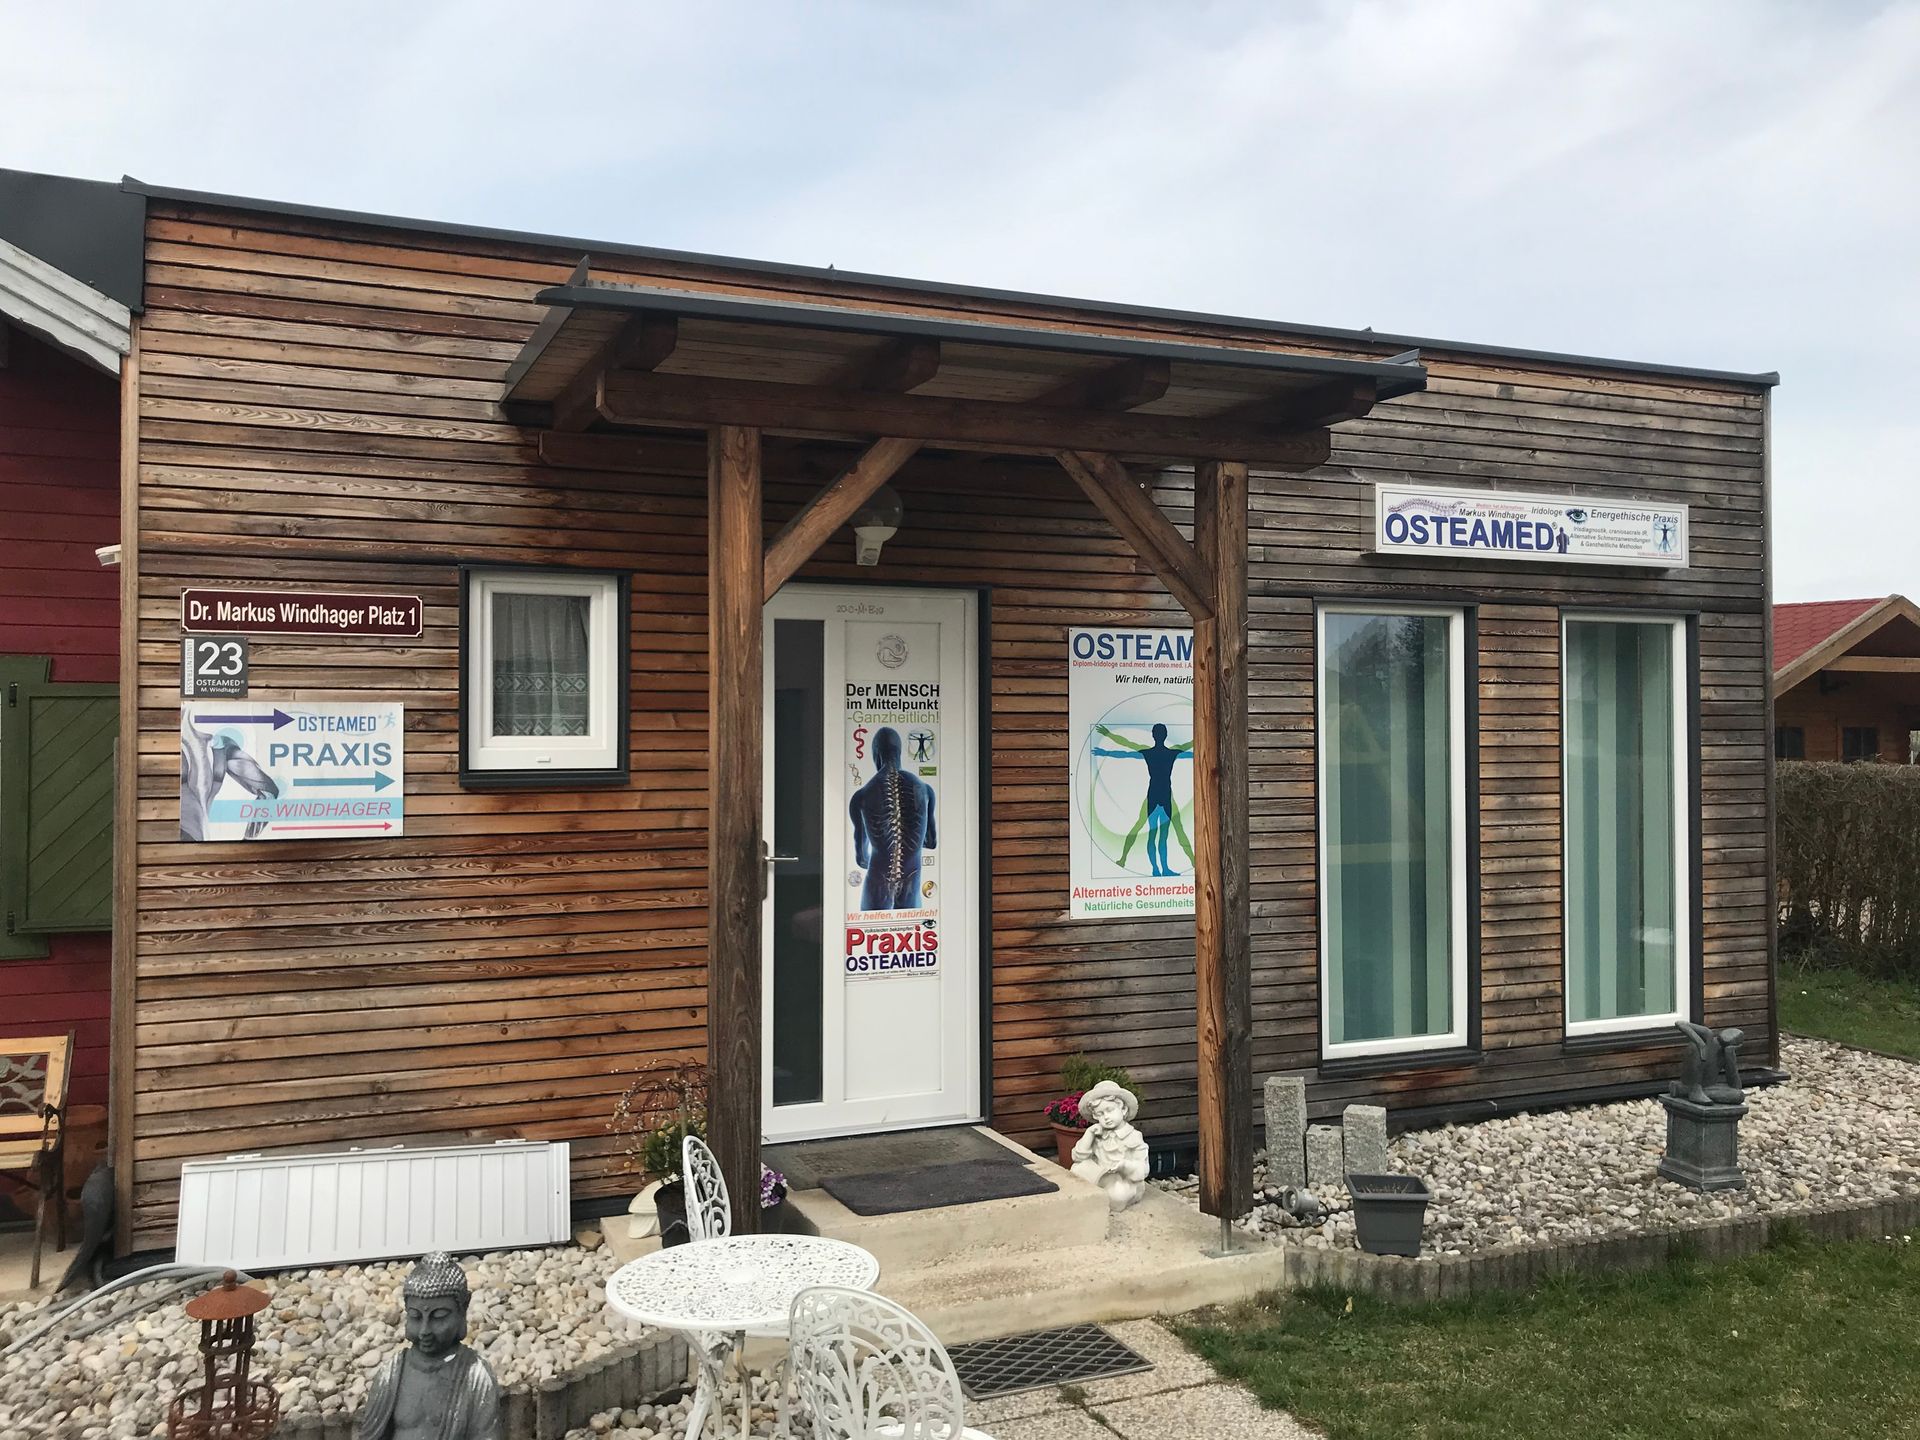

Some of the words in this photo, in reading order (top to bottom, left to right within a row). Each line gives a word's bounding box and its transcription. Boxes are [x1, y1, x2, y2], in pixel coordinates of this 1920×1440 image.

[1459, 508, 1486, 517] Markus
[1488, 510, 1527, 520] Windhager
[1532, 506, 1562, 517] Iridologe
[1590, 509, 1650, 522] Energethische
[1653, 514, 1678, 523] Praxis
[190, 600, 212, 621] Dr.
[217, 602, 275, 622] Markus
[280, 603, 364, 628] Windhager
[369, 606, 404, 626] Platz
[409, 607, 416, 625] 1
[198, 642, 243, 675] 23
[1116, 675, 1129, 684] Wir
[1132, 675, 1161, 684] helfen,
[846, 684, 871, 697] Der
[876, 684, 940, 697] MENSCH
[847, 699, 861, 710] im
[867, 698, 938, 712] Mittelpunkt
[269, 742, 392, 767] PRAXIS
[240, 804, 273, 819] Drs.
[276, 801, 392, 817] WINDHAGER
[1073, 886, 1132, 898] Alternative
[1135, 884, 1194, 896] Schmerzbe
[1084, 900, 1133, 911] Natürliche
[1136, 899, 1194, 909] Gesundheits
[863, 912, 894, 920] helfen,
[896, 909, 938, 918] natürlich!
[846, 924, 938, 956] Praxis
